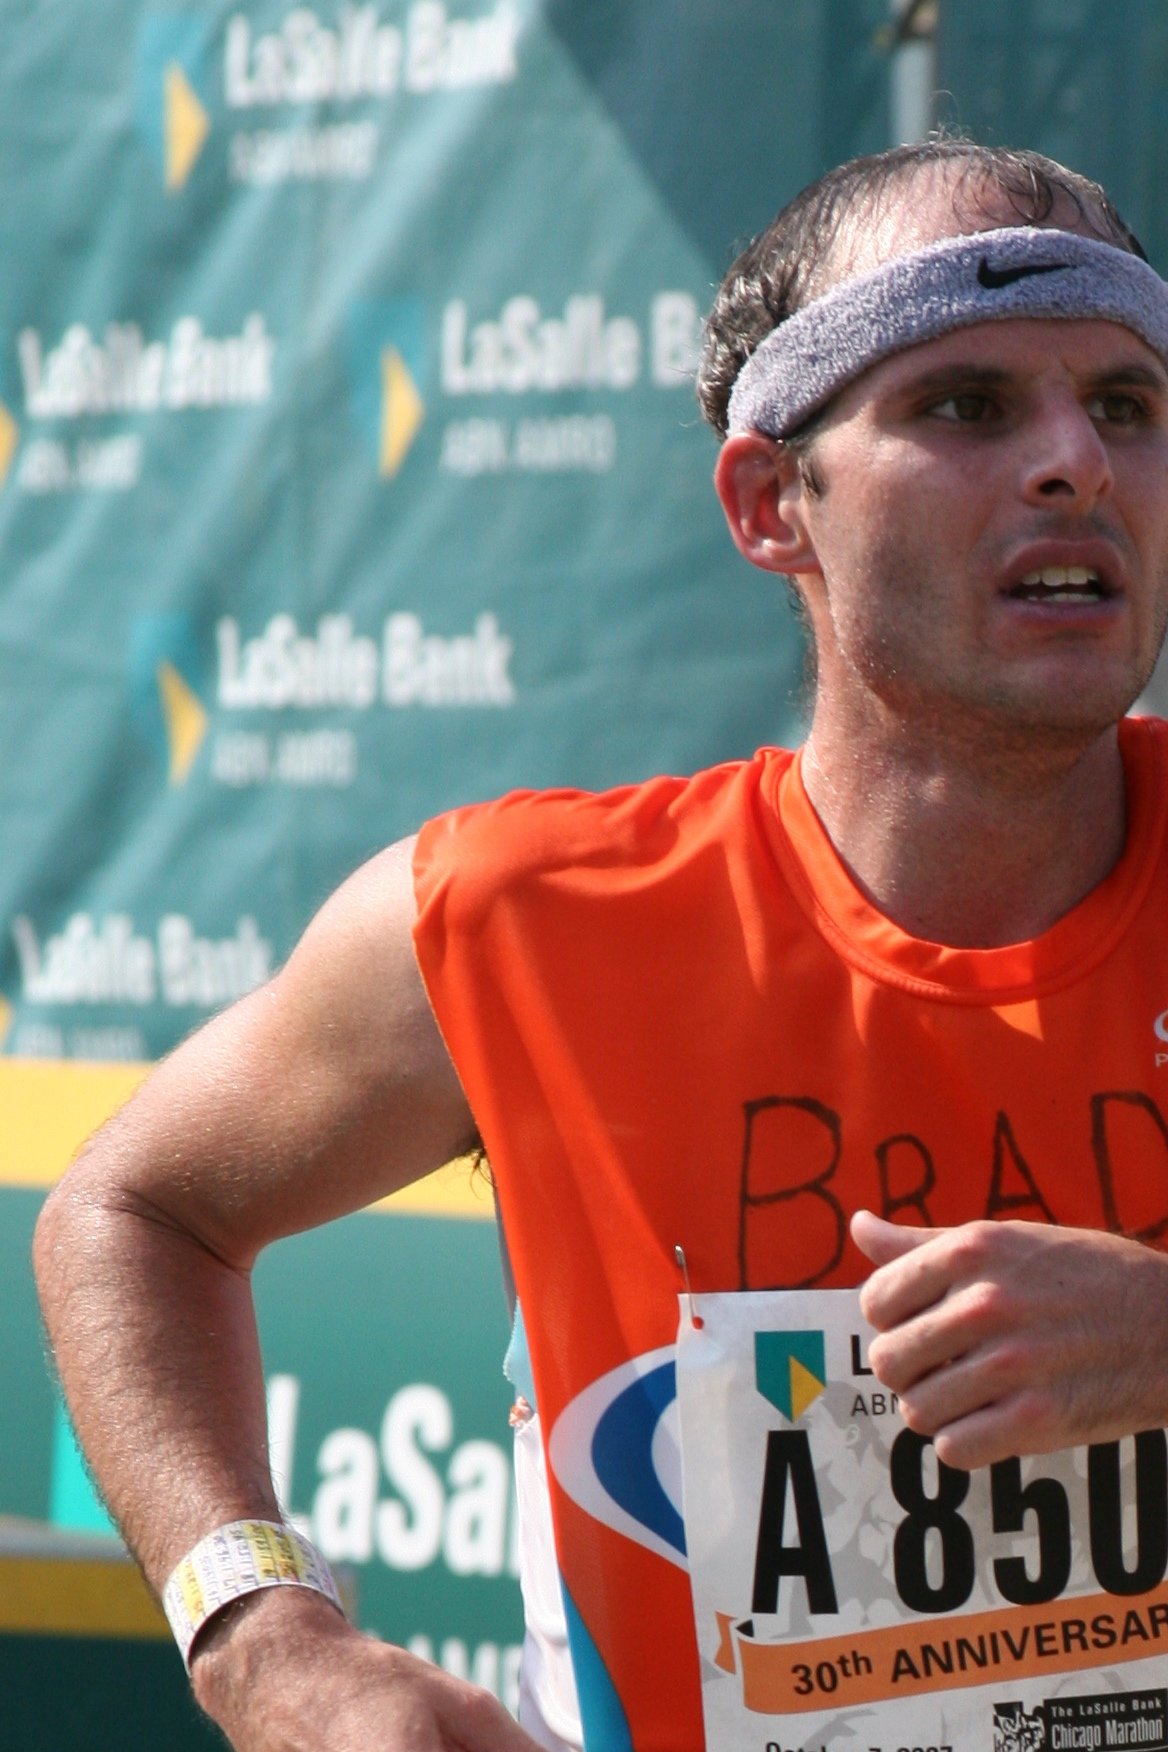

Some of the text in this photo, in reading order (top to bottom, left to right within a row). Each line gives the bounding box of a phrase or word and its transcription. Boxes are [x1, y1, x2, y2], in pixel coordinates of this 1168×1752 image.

[443, 295, 640, 393] LaSalle
[384, 611, 514, 706] Bank
[851, 1334, 874, 1376] L
[751, 1428, 1168, 1614] A 850
[790, 1649, 873, 1697] 30th
[1051, 1697, 1162, 1718] The LaSalle Bank
[1051, 1717, 1163, 1752] Chicago Marathon
